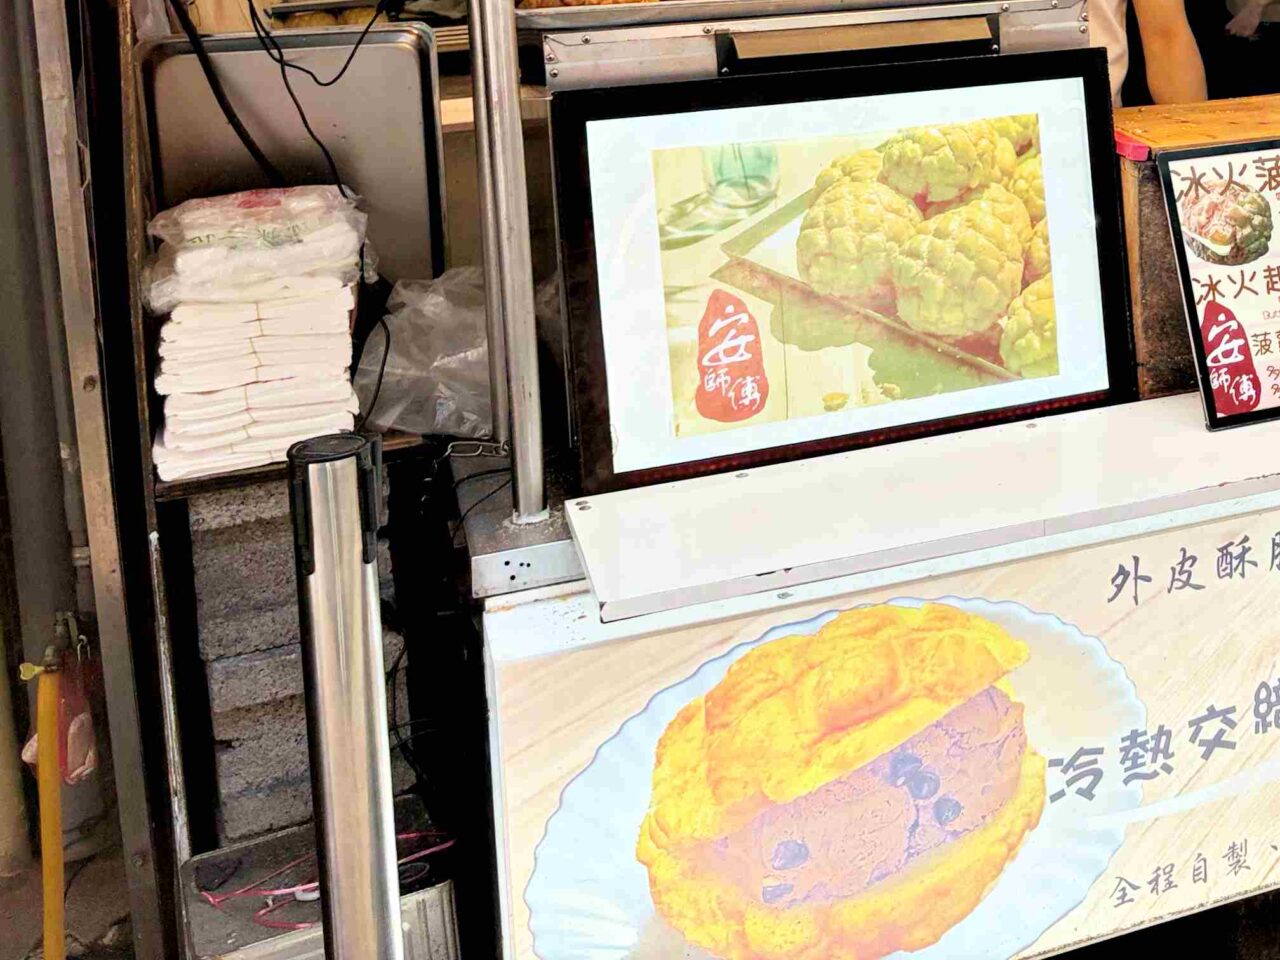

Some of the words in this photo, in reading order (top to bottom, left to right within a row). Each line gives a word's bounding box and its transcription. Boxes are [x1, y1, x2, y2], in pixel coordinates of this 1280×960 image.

[702, 304, 761, 412] 安師傅
[1206, 312, 1257, 406] 安師傅
